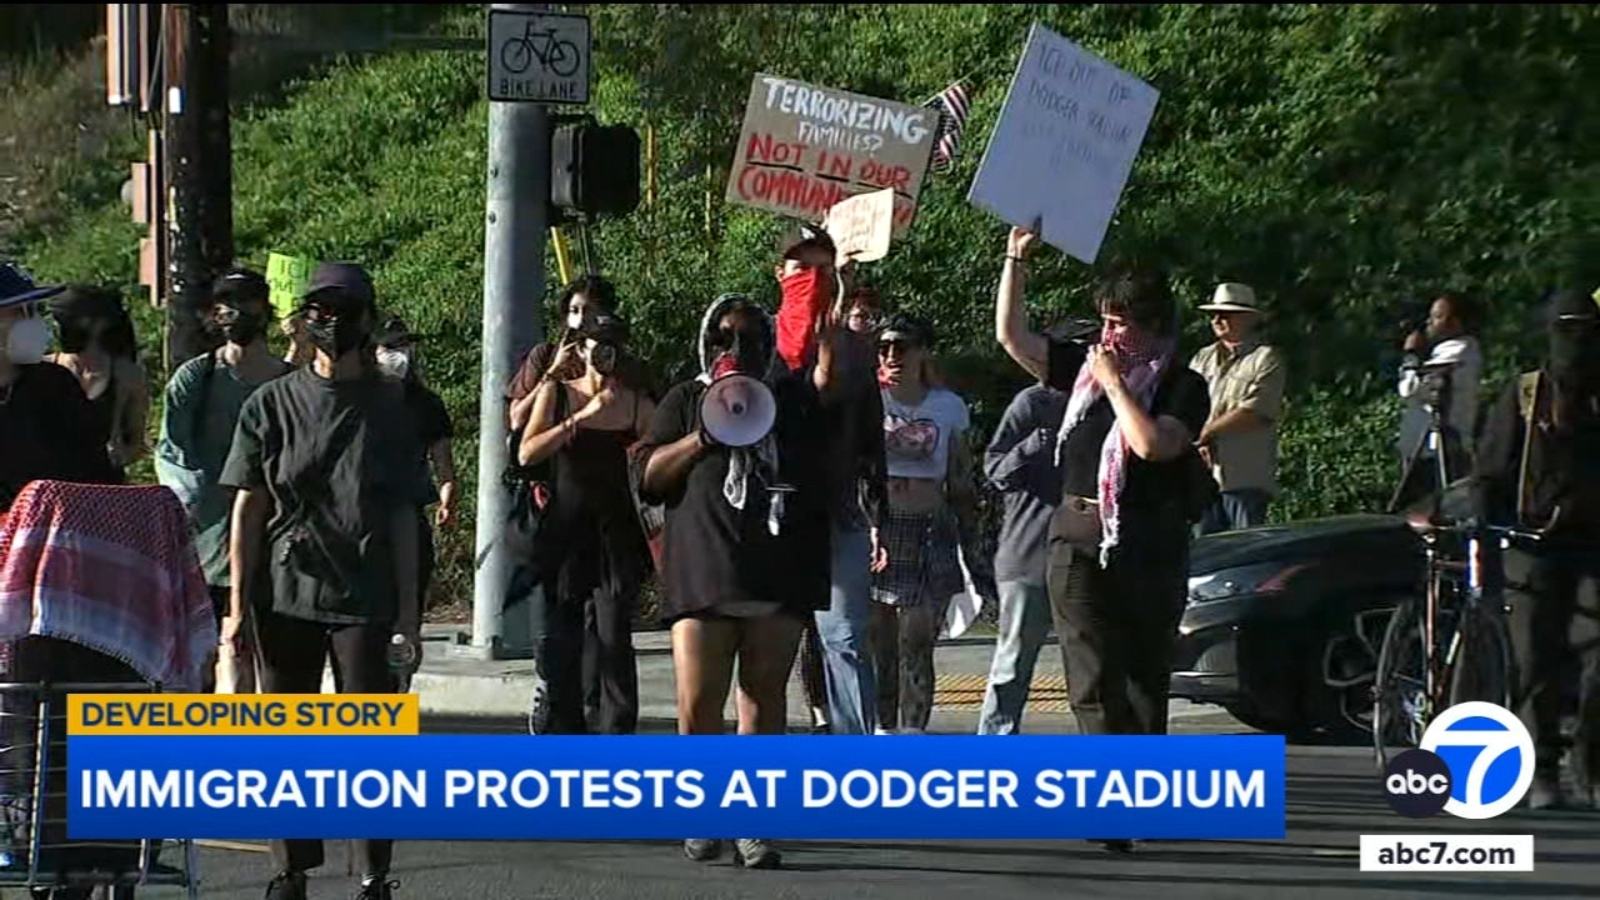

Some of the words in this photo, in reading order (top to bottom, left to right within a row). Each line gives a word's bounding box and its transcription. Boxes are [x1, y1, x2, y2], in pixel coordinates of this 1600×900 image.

[500, 78, 533, 96] BIKE
[538, 81, 577, 99] LANE
[763, 77, 929, 144] TERRORIZING
[746, 132, 807, 164] NOT
[816, 149, 852, 176] IN
[859, 158, 911, 191] OUR
[799, 121, 884, 158] FAMILIES?
